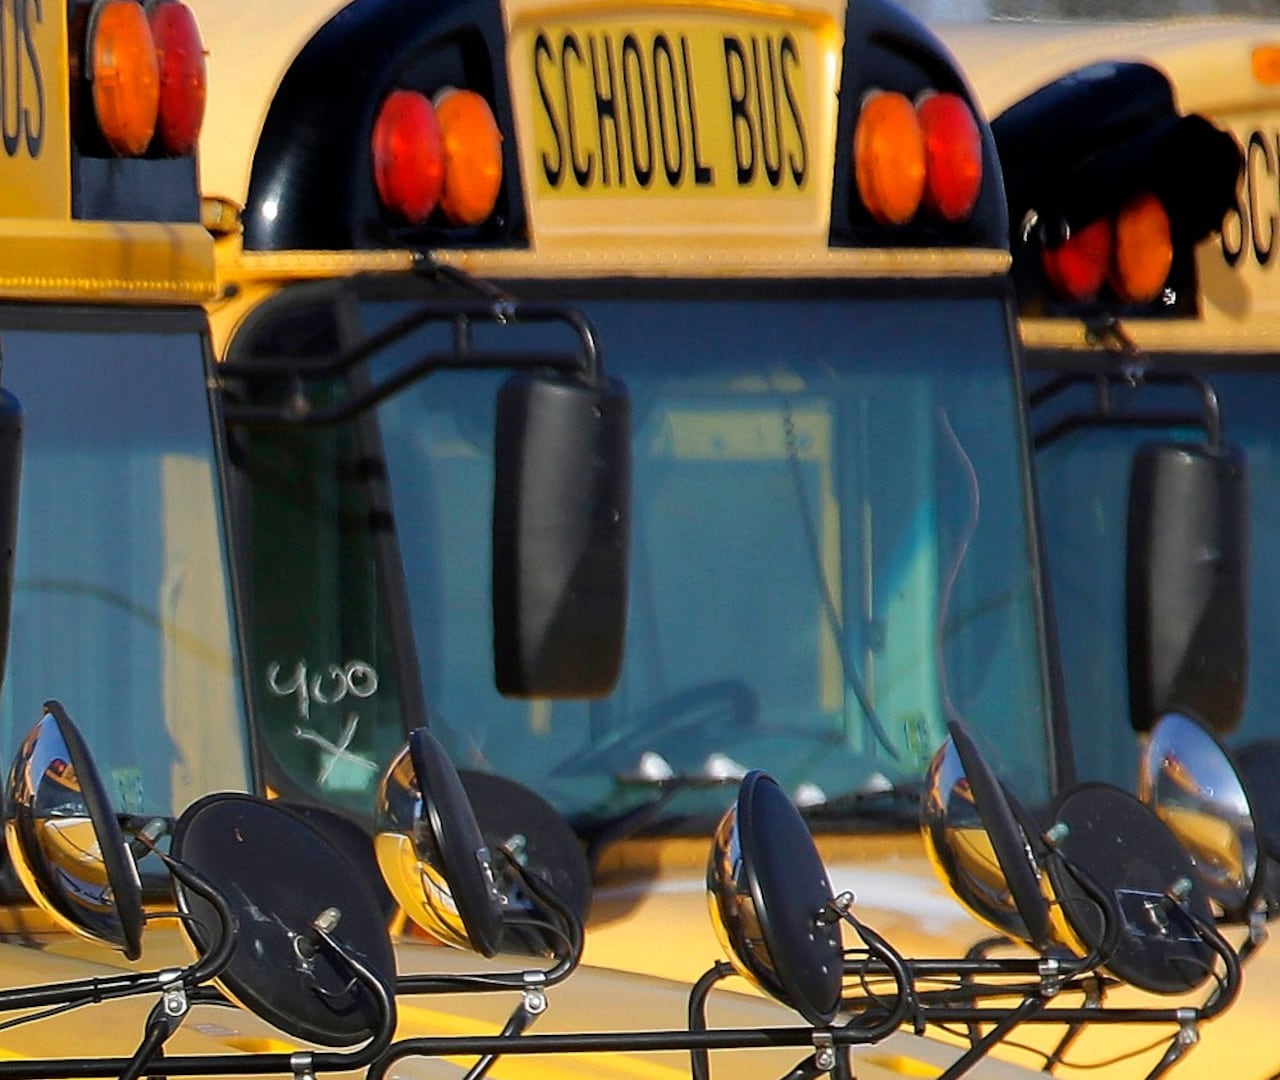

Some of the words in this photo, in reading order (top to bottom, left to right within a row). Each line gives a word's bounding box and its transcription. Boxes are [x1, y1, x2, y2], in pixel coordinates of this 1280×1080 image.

[534, 32, 716, 188] SCHOOL
[722, 35, 810, 188] BUS
[268, 660, 378, 721] 400
